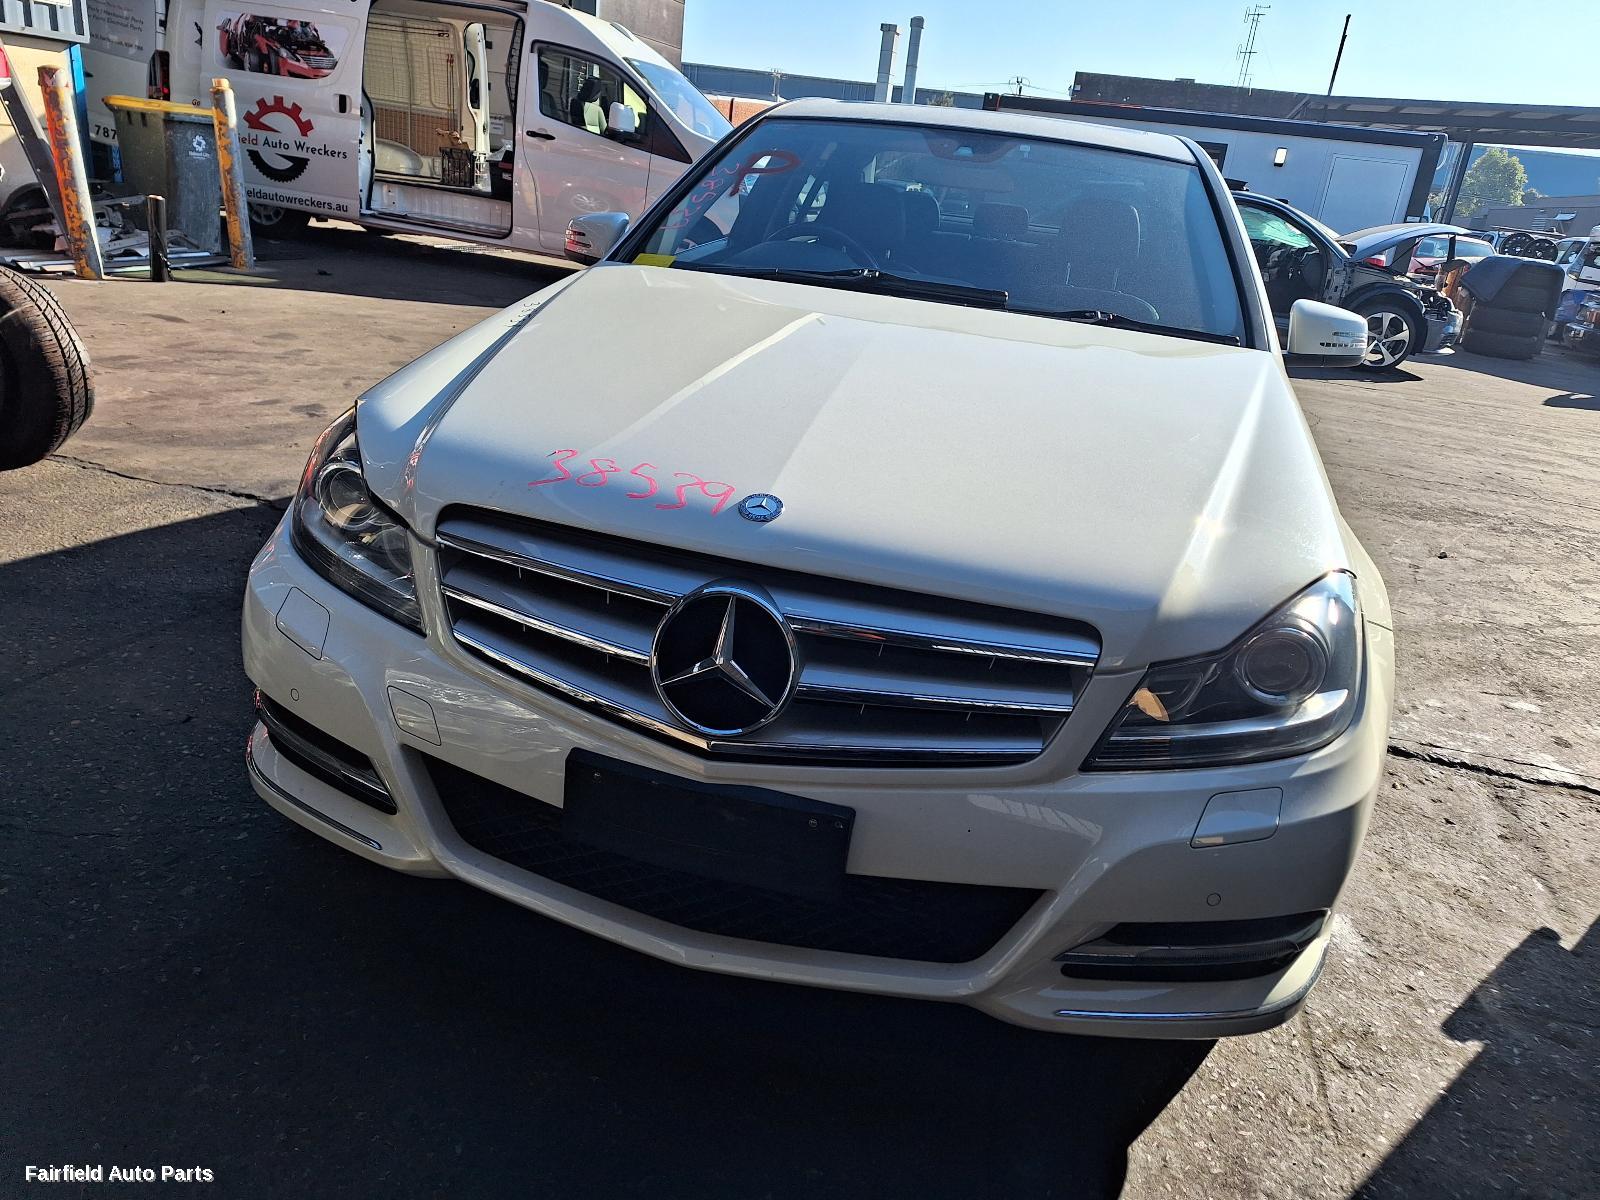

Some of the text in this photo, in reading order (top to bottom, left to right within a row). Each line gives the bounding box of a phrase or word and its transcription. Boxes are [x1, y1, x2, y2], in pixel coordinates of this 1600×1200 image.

[237, 132, 348, 160] ield Auto Wreckers
[245, 187, 348, 213] eldautowreckers.au
[528, 449, 736, 516] 38539
